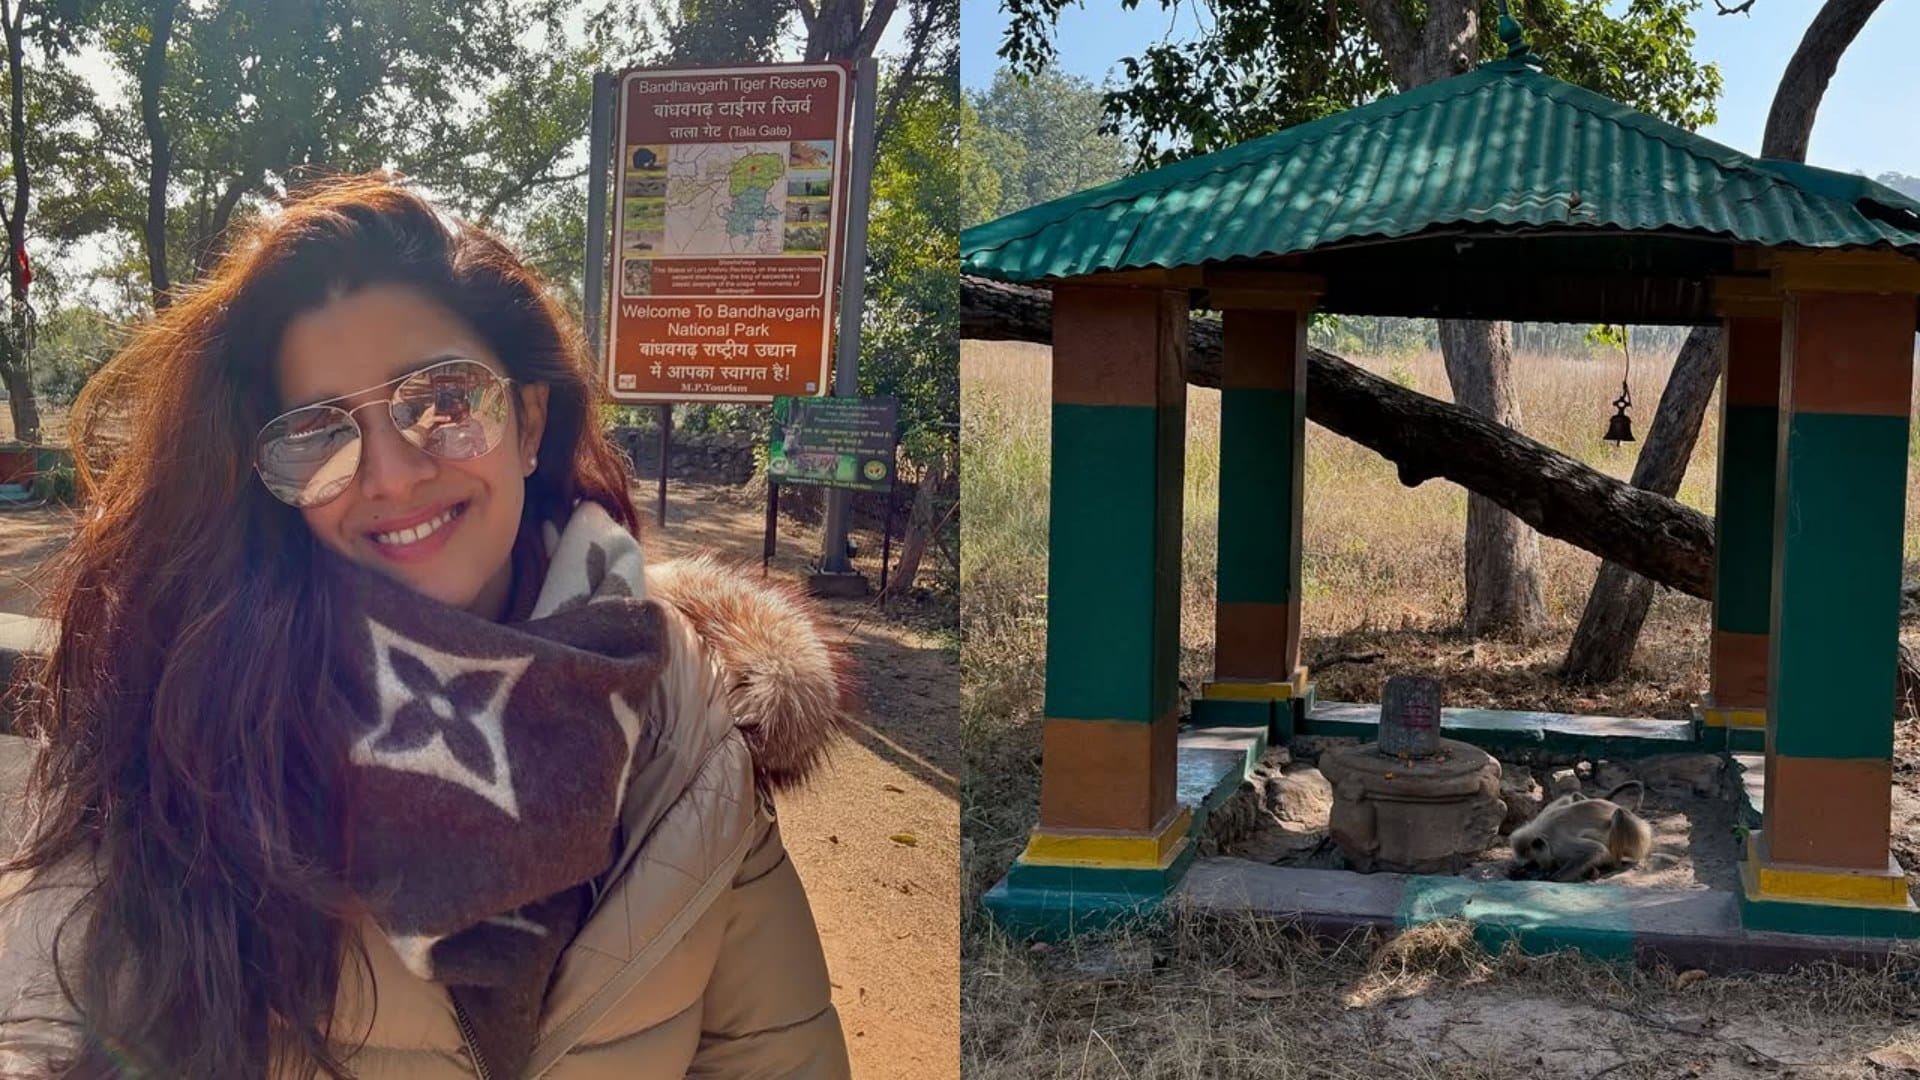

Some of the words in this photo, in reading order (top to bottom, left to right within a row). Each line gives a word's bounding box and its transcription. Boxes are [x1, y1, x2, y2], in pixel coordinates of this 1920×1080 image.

[639, 79, 728, 95] Bandhavgarh
[731, 77, 766, 93] Tiger
[769, 76, 828, 90] Reserve
[653, 98, 713, 119] बांधवगढ़
[718, 96, 766, 118] टाईगर
[772, 94, 812, 115] रिजर्व
[670, 126, 698, 138] ताला
[703, 123, 721, 137] गेट
[728, 125, 756, 139] (Tala
[759, 124, 792, 138] Gate)
[622, 305, 691, 319] Welcome
[696, 305, 713, 319] To
[718, 304, 821, 321] Bandhavgarh
[668, 322, 730, 337] National
[734, 322, 770, 337] Park
[639, 338, 698, 359] बांधवगढ़
[703, 338, 749, 360] राष्ट्रीय
[754, 341, 798, 358] उद्यान
[649, 361, 662, 379] में
[667, 365, 715, 380] आपका
[720, 365, 768, 380] स्वागत
